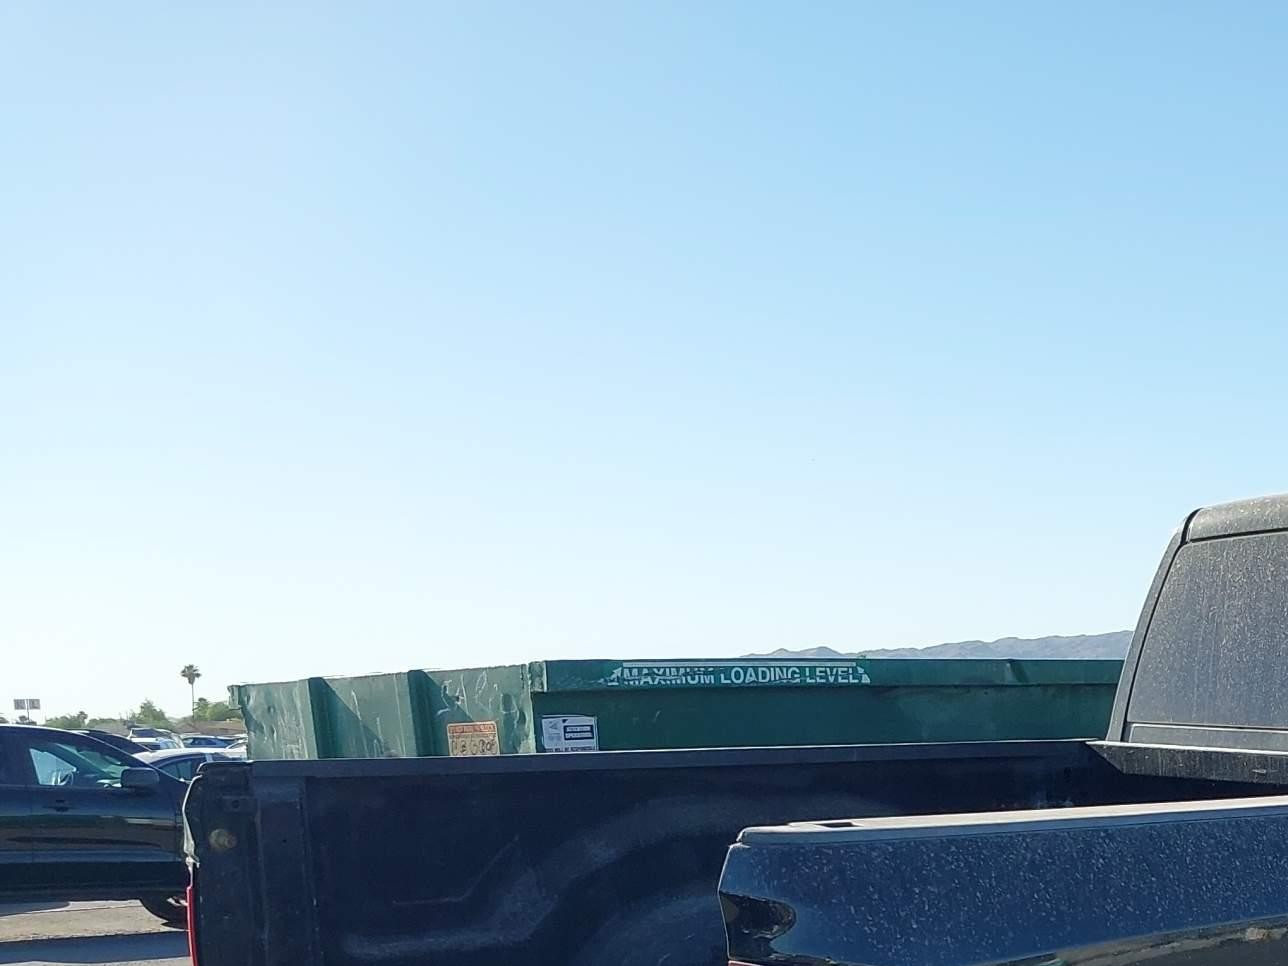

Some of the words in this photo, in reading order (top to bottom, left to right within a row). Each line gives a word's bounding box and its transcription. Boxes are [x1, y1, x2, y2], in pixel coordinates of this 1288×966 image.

[623, 666, 715, 685] MAXIMUM
[721, 666, 801, 684] LOADING
[805, 666, 859, 684] LEVEL
